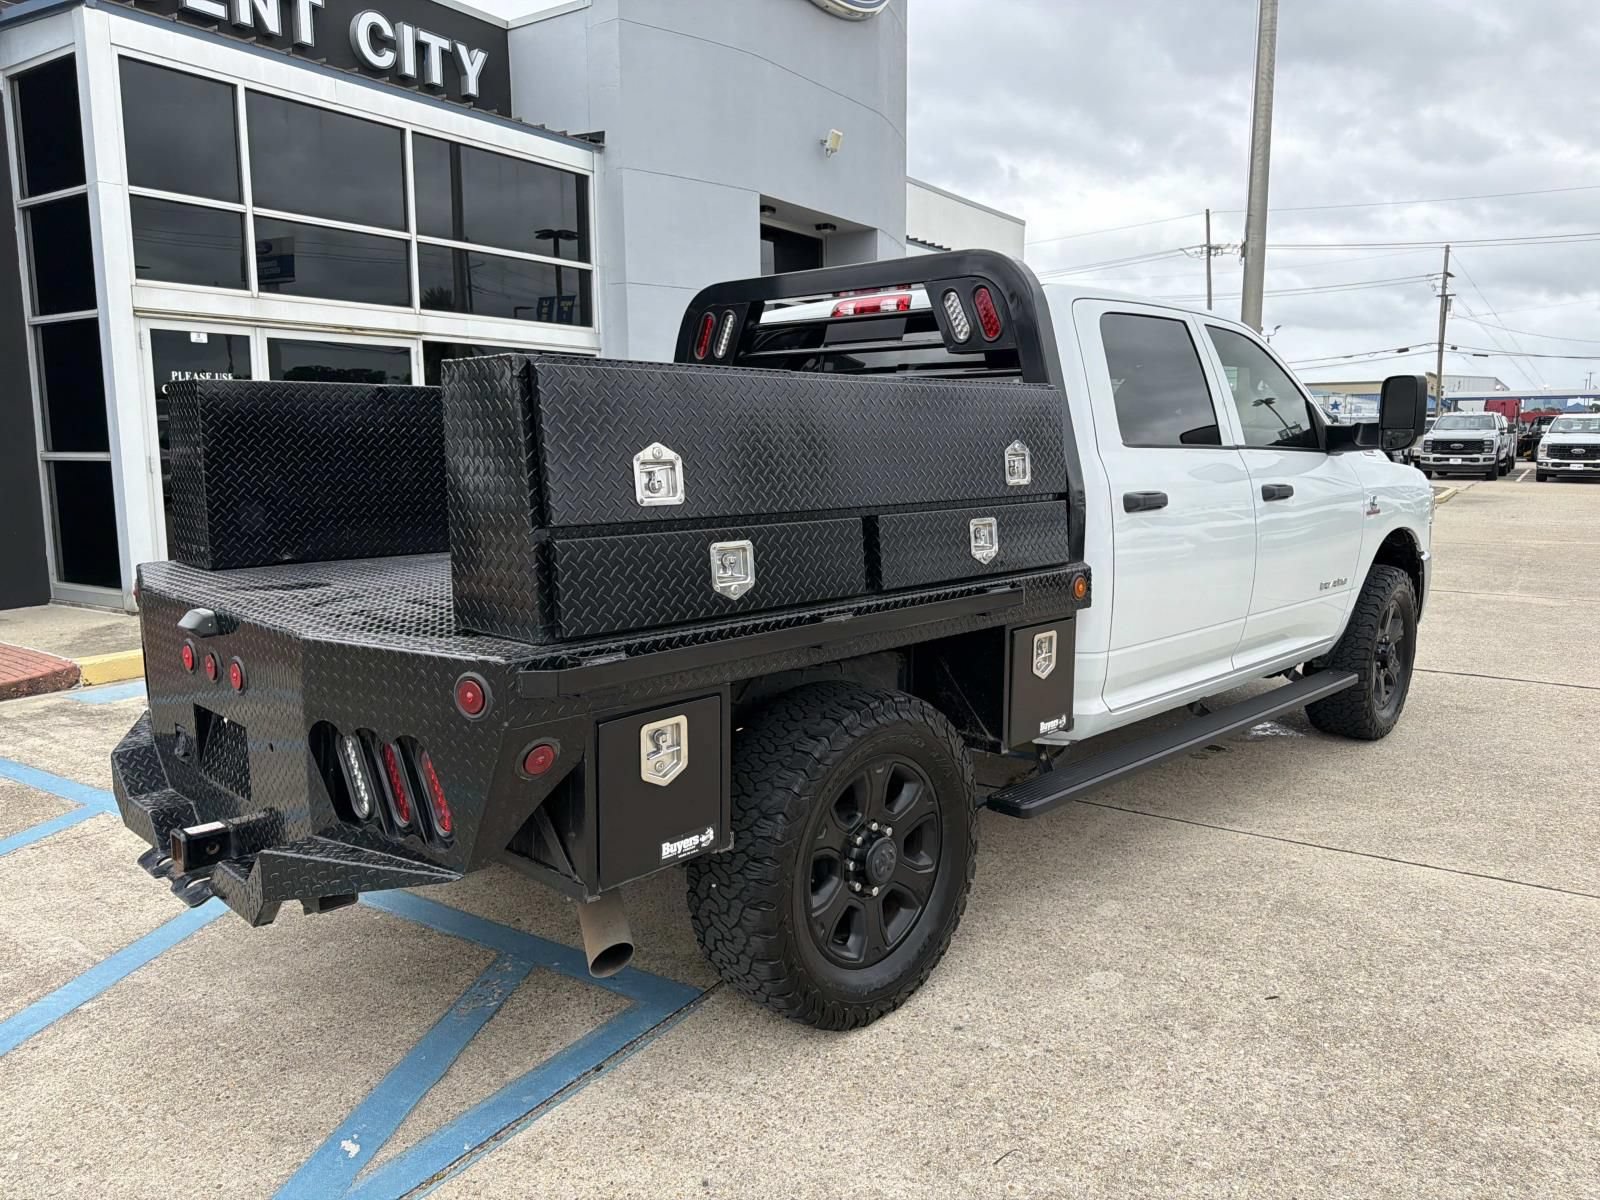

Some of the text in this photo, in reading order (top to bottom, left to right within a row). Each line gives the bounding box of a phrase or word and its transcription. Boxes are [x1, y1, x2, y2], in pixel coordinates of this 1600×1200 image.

[180, 0, 488, 98] NT CITY
[171, 370, 212, 381] PLEASE
[661, 835, 700, 857] Buyers
